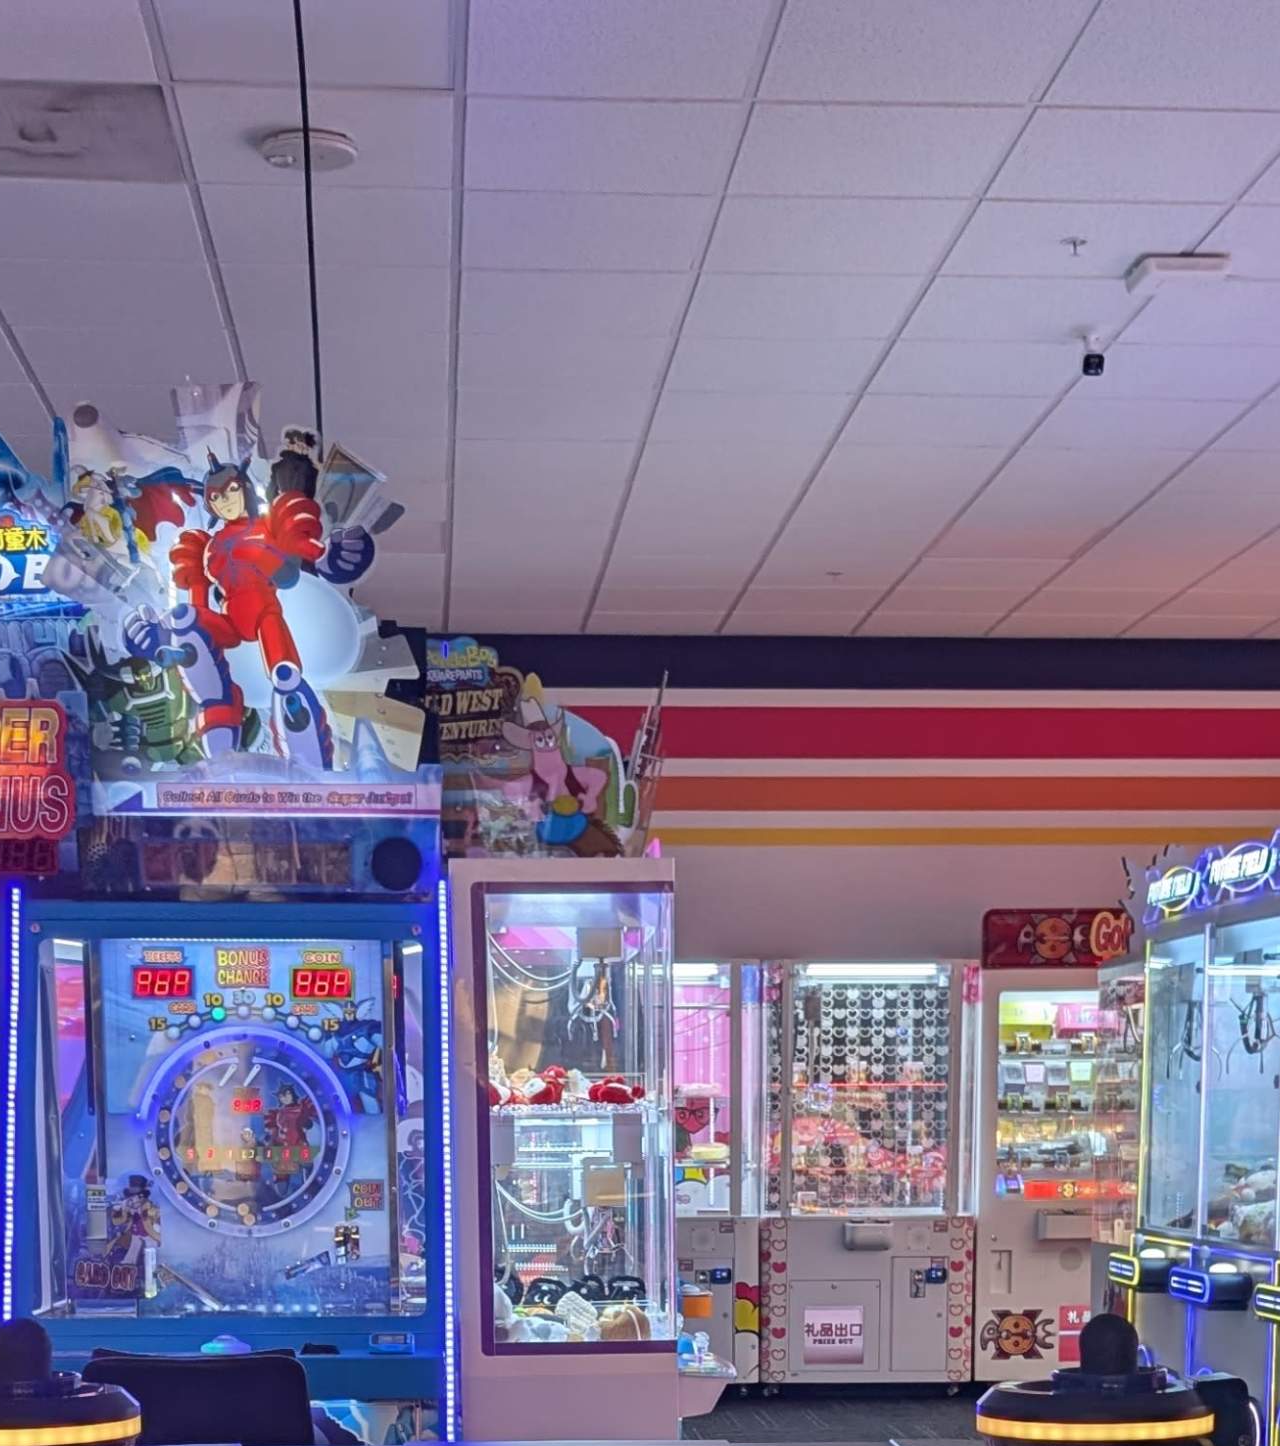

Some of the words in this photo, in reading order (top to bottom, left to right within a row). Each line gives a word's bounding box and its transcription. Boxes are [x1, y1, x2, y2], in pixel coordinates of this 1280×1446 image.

[456, 689, 503, 715] WEST
[163, 790, 204, 804] Collect
[206, 790, 224, 803] All
[225, 790, 260, 804] Cards
[262, 791, 276, 804] to
[277, 791, 300, 805] Win
[302, 791, 322, 805] the
[217, 948, 268, 967] BONUS
[303, 951, 341, 964] COIN
[218, 968, 267, 985] CHANCE
[203, 993, 223, 1007] 10
[232, 990, 256, 1006] 30
[265, 993, 285, 1008] 10
[149, 1017, 167, 1032] 15
[323, 1018, 340, 1033] 15
[352, 1183, 382, 1196] COIN
[354, 1196, 382, 1209] OUT
[804, 1322, 863, 1337] 礼品出口
